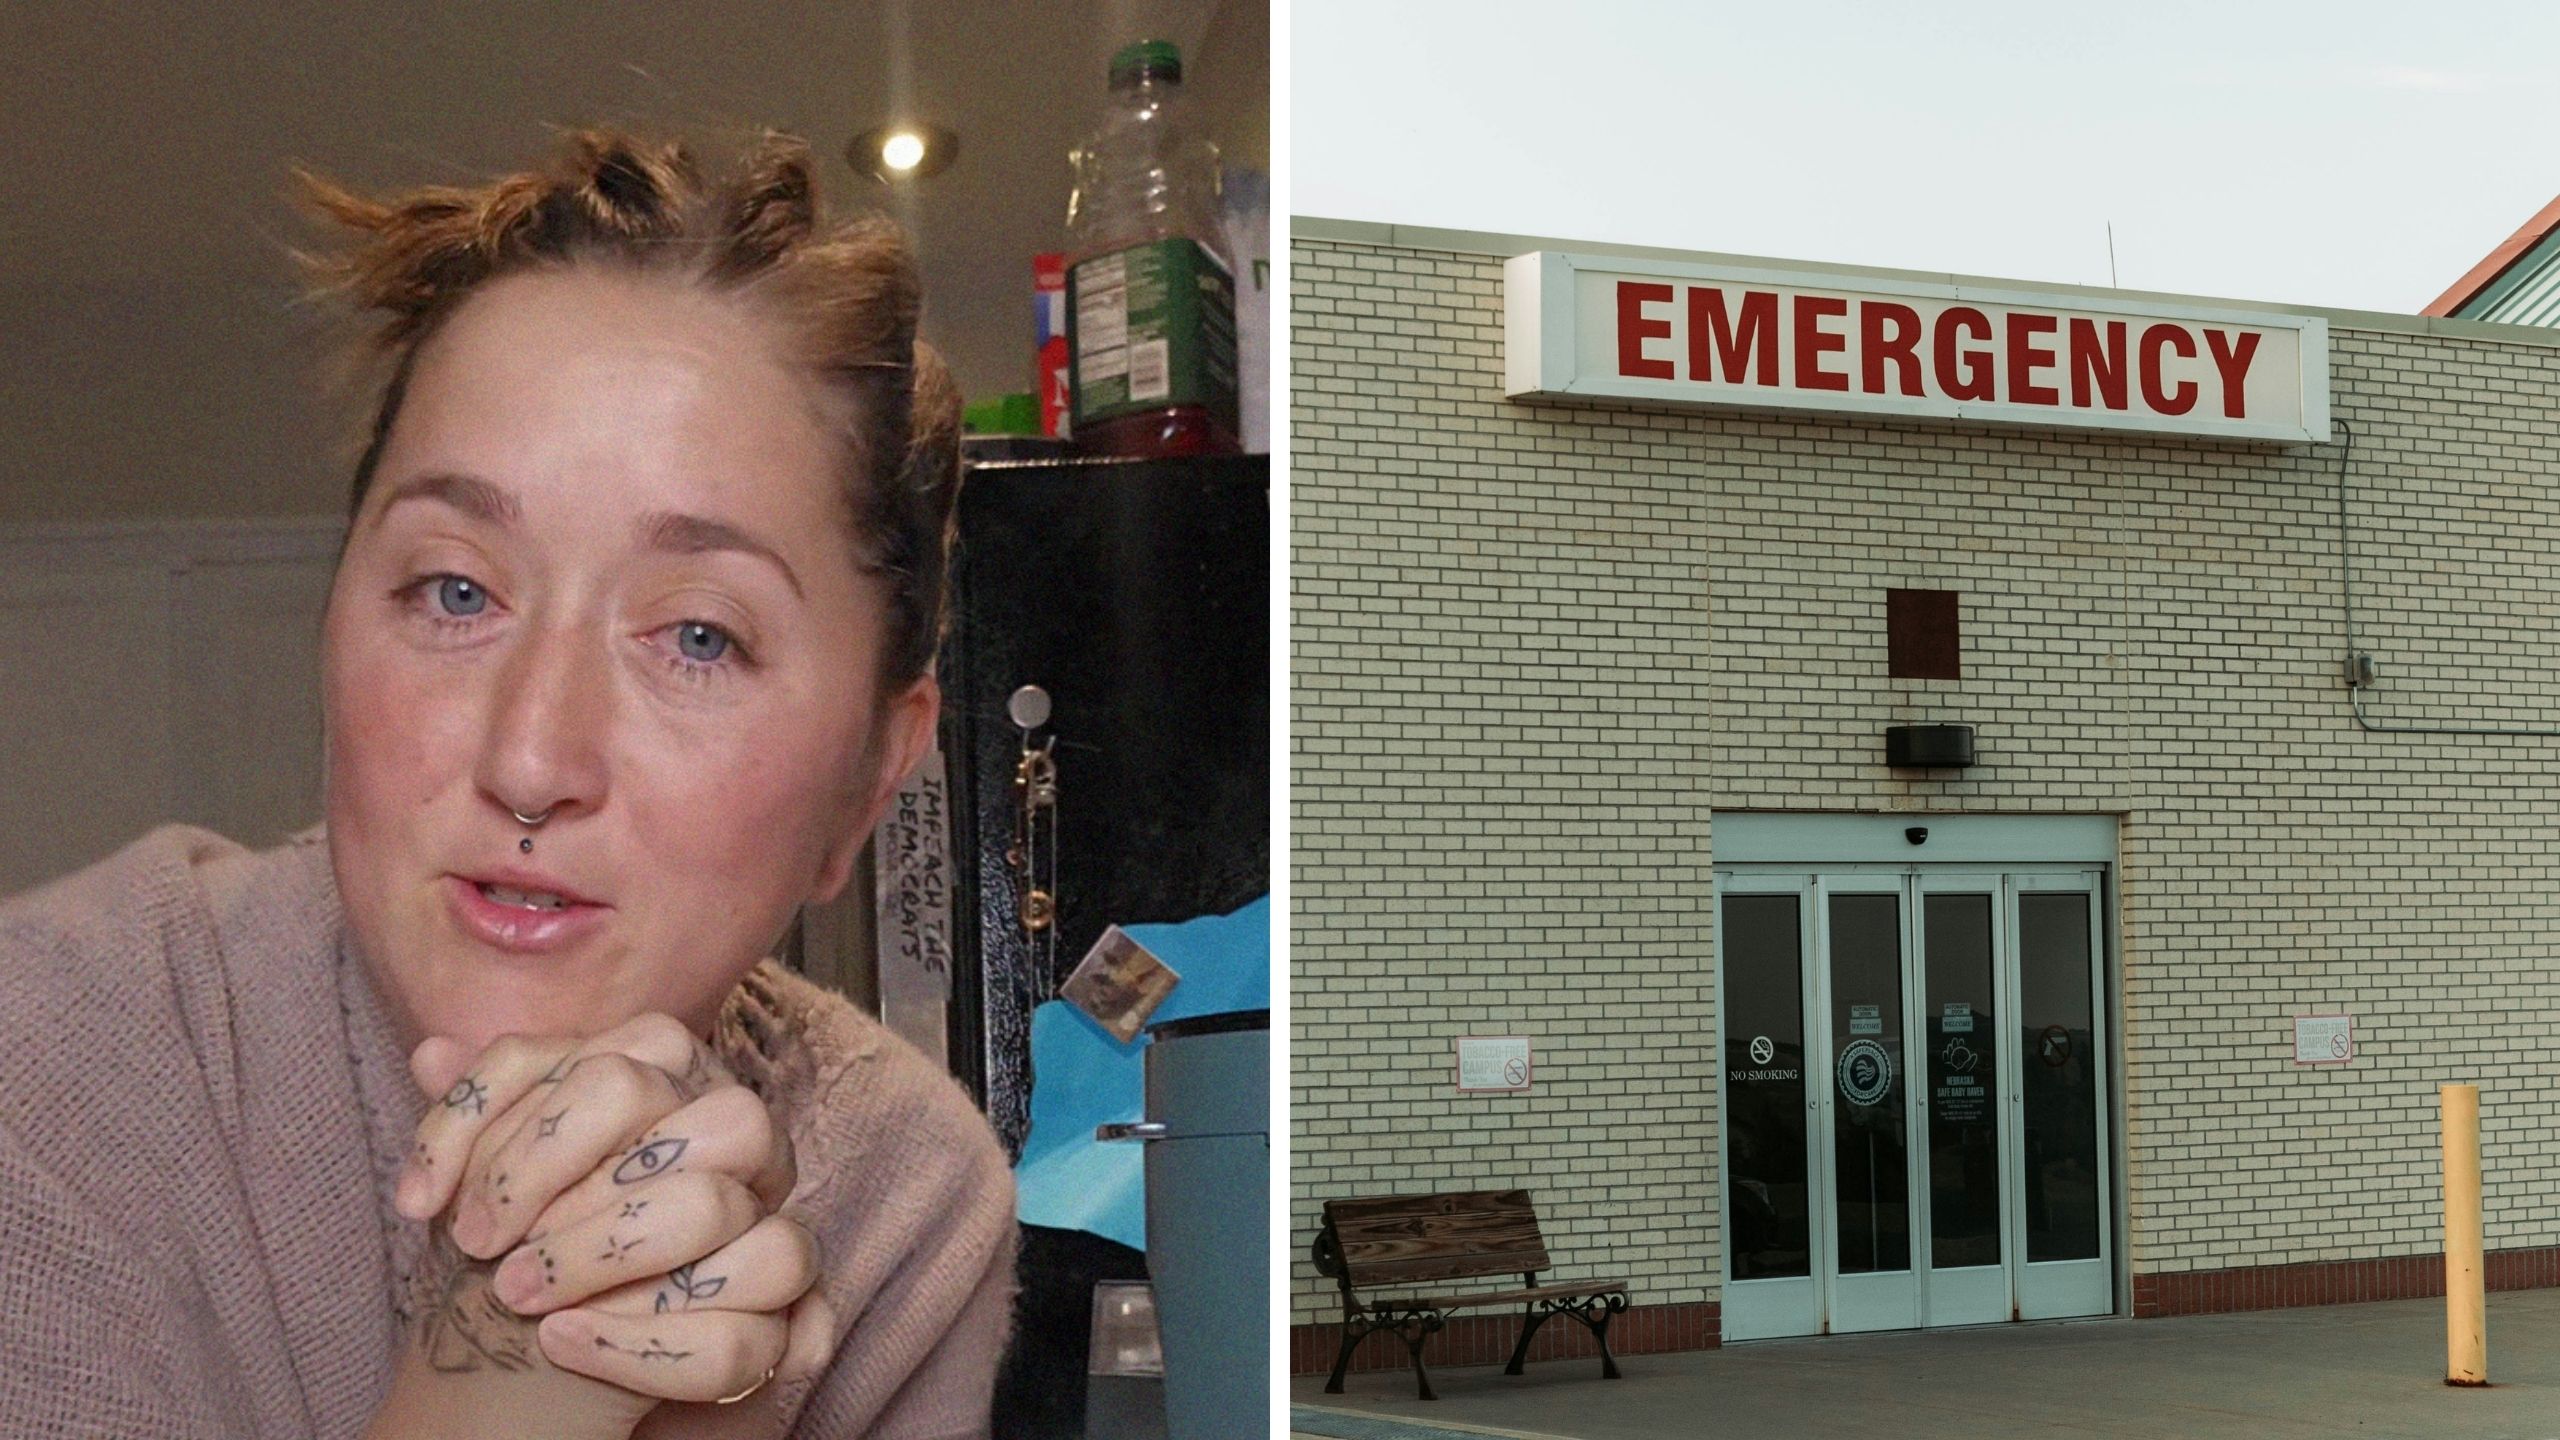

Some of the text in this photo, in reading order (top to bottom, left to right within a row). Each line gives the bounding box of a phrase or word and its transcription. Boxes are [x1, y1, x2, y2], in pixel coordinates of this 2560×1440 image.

[1617, 280, 2262, 419] EMERGENCY
[899, 791, 921, 962] DEMOCRATS
[922, 776, 944, 974] IMPEACH THE
[2299, 1037, 2329, 1049] CAMPUS
[1462, 1046, 1526, 1059] TOBACCO-FREE
[1463, 1060, 1503, 1075] CAMPUS
[1730, 1069, 1798, 1081] NO SMOKING
